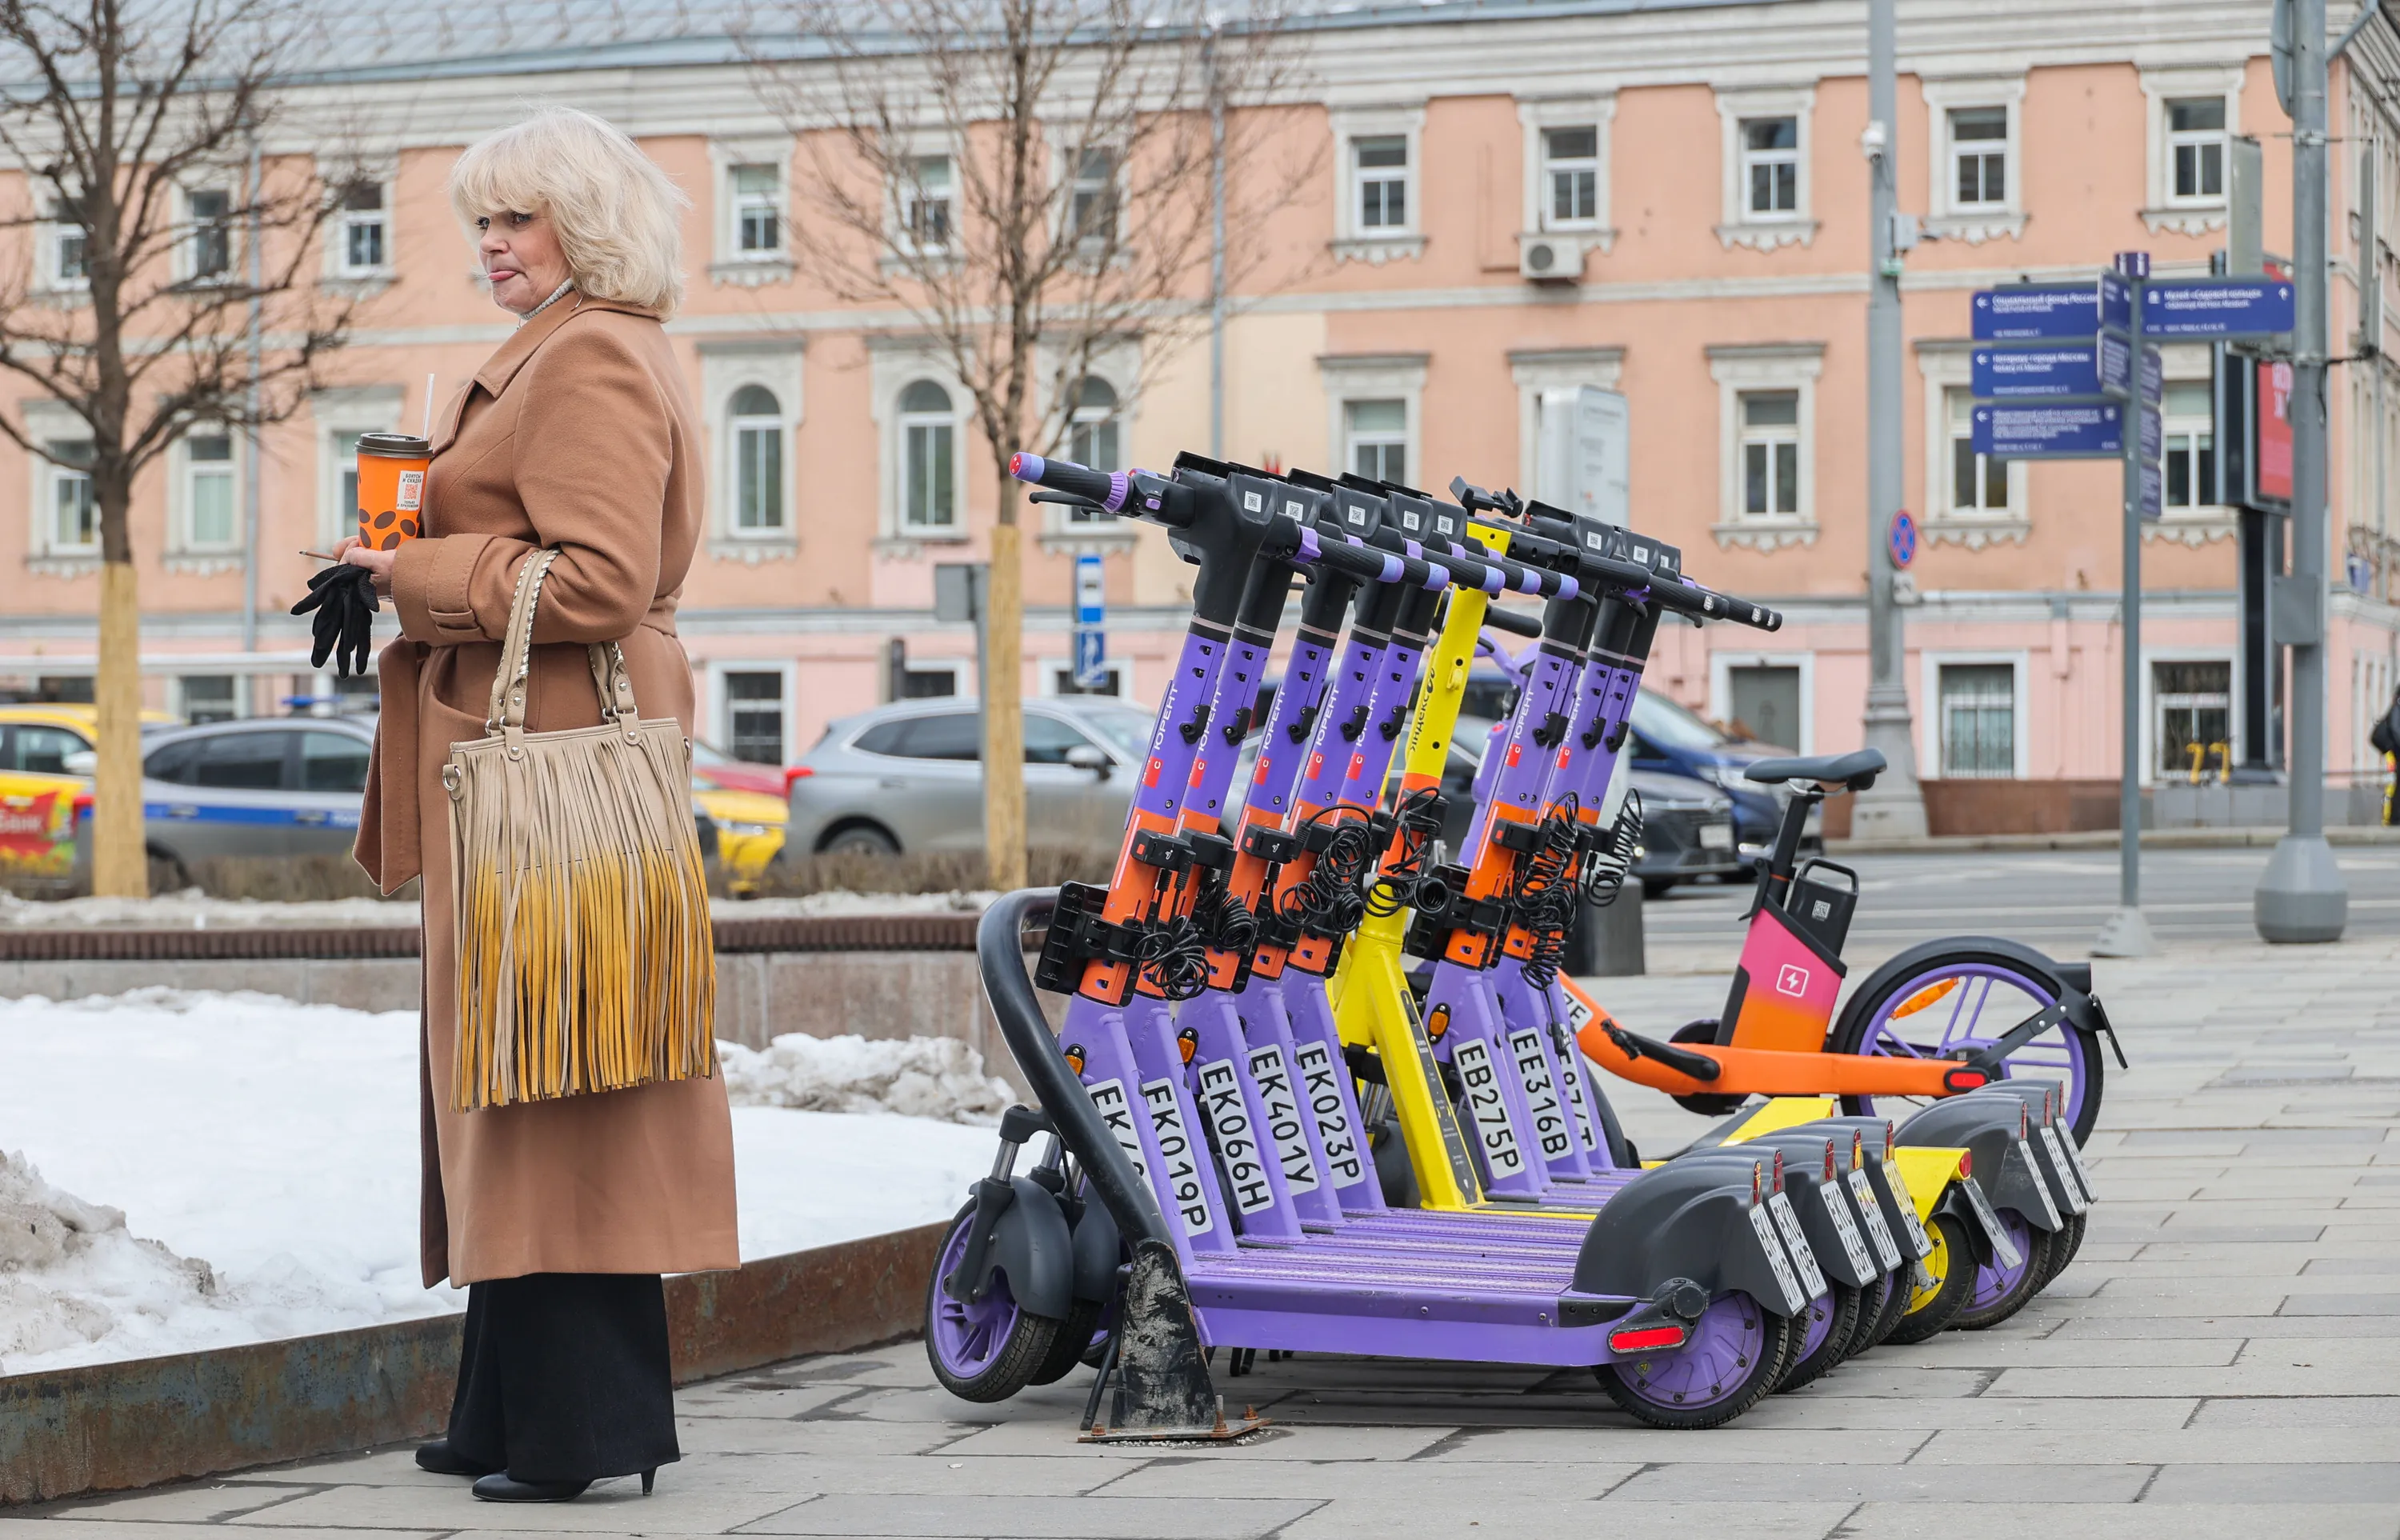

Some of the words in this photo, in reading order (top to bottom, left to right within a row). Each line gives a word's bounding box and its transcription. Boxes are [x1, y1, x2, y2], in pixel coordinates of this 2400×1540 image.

[1154, 683, 1178, 750] ЮРЕНТ
[1198, 686, 1222, 752] ЮРЕНТ
[1263, 686, 1286, 750] ЮРЕНТ
[1315, 685, 1339, 746] ЮРЕНТ
[1514, 688, 1534, 738] ЮРЕНТ
[1564, 694, 1582, 742] ЮРЕНТ
[1298, 1047, 1359, 1178] ЕК023Р
[1458, 1044, 1518, 1168] ЕВ275Р
[1513, 1033, 1568, 1154] ЕЕ316В
[1144, 1084, 1206, 1226] ЕК019Р
[1202, 1065, 1270, 1208] ЕК066Н
